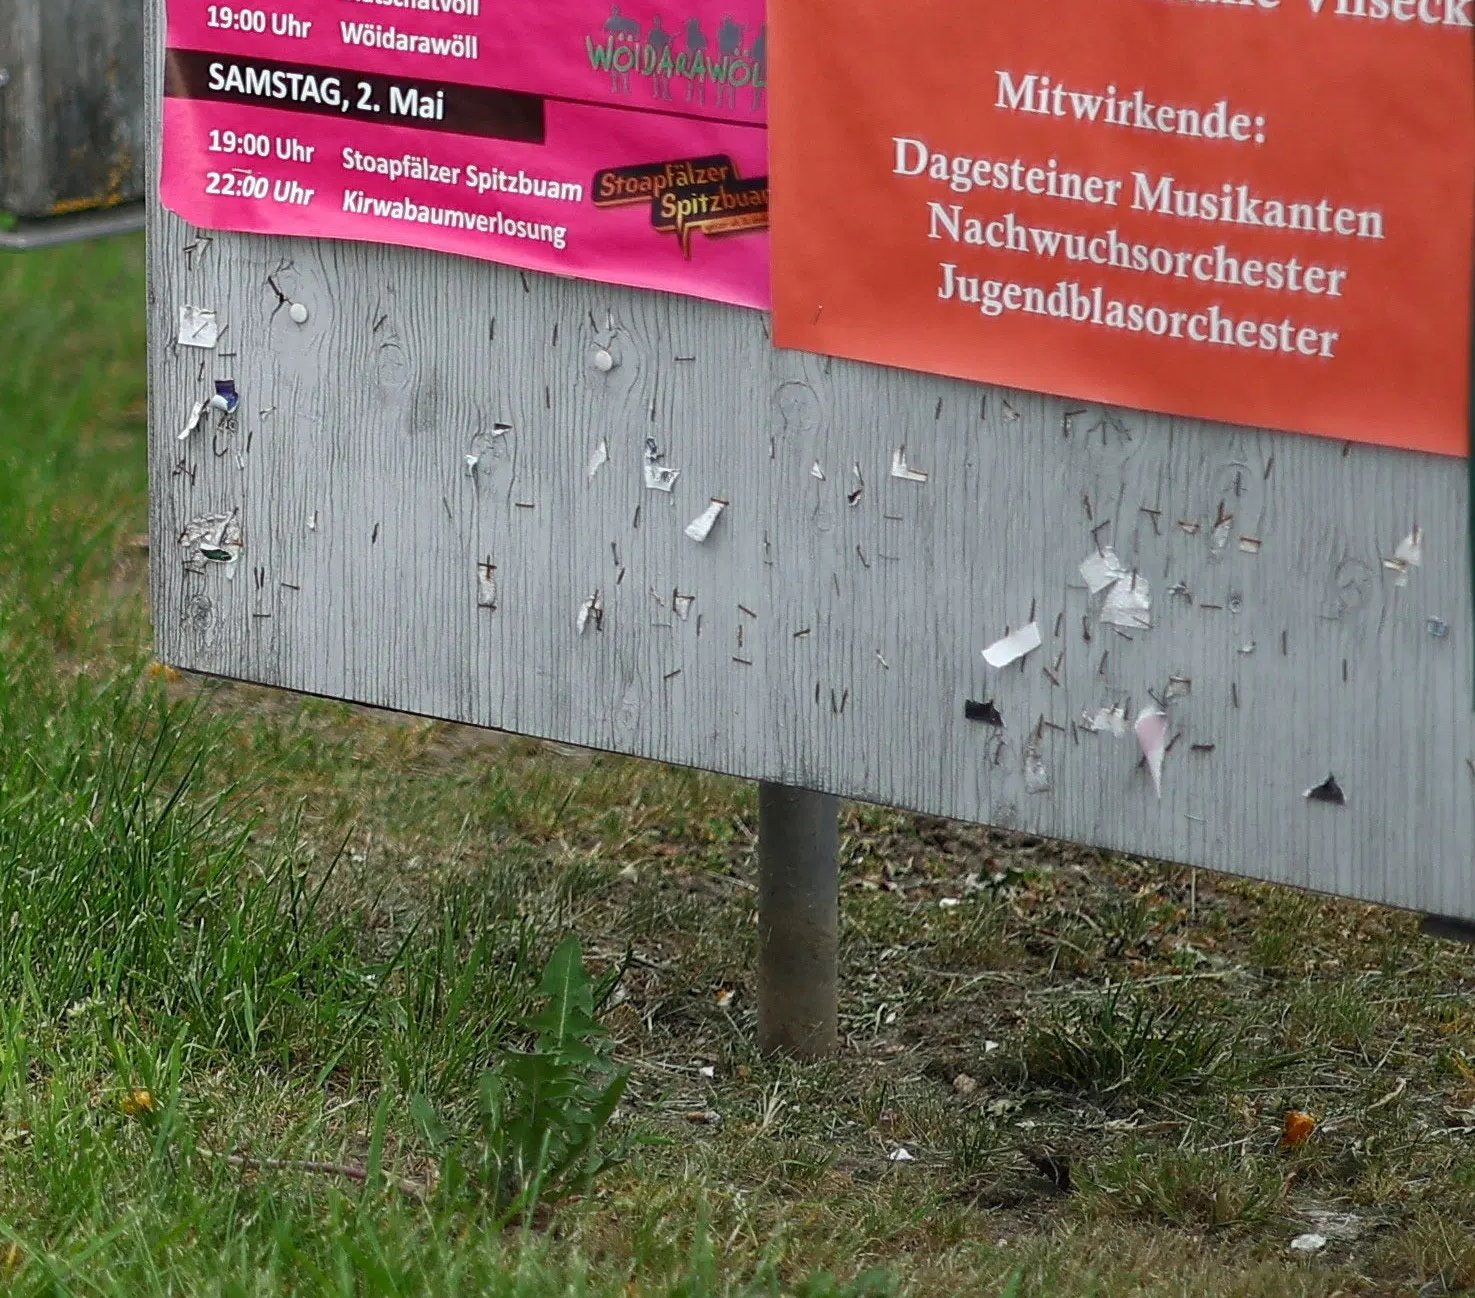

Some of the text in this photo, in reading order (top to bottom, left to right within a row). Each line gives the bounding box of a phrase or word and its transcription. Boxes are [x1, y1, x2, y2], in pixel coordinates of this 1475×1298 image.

[206, 5, 478, 60] 19:00 Uhr Wöidarawöll
[209, 63, 444, 120] SAMSTAG, 2. Mai
[994, 70, 1266, 143] Mitwirkende:
[208, 129, 583, 203] 19:00 Uhr Stoapfälzer Spitzbuam
[599, 161, 730, 200] Stoapfälzer
[891, 137, 1386, 239] Dagesteiner Musikanten
[205, 172, 567, 250] 22:00 Uhr Kirwabaumverlosung
[660, 186, 769, 227] Spitzbua
[927, 202, 1347, 297] Nachwuchsorchester
[937, 263, 1338, 358] Jugendblasorchester
